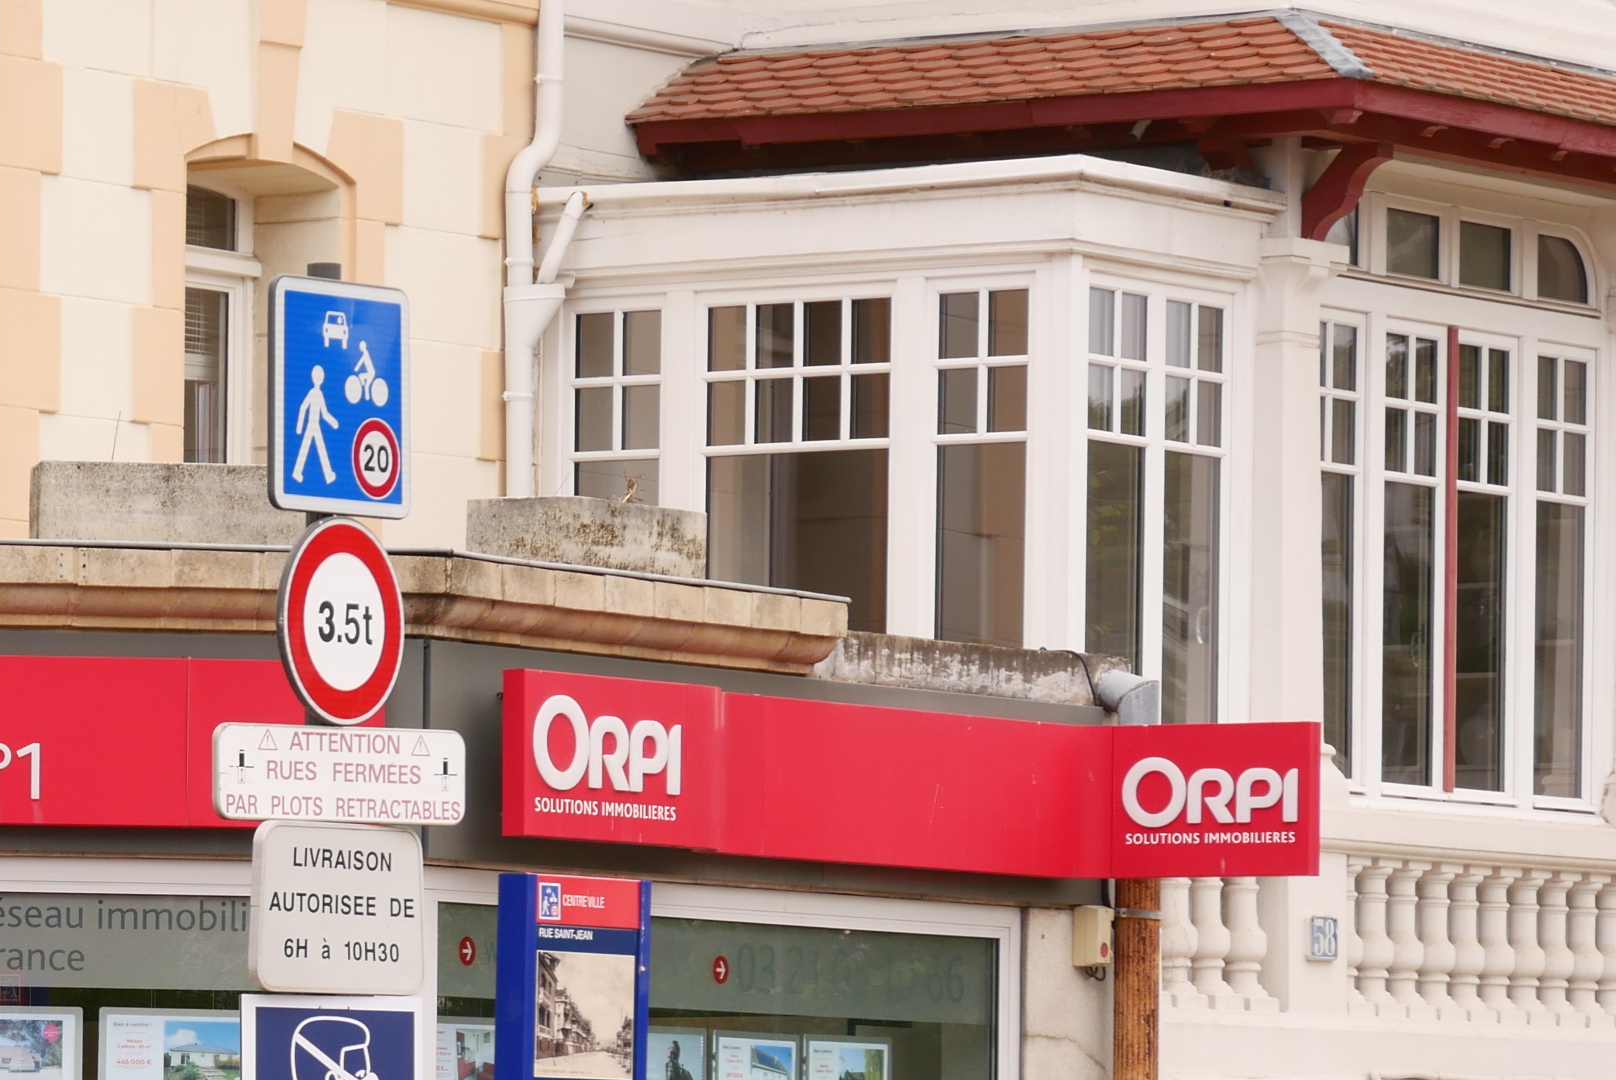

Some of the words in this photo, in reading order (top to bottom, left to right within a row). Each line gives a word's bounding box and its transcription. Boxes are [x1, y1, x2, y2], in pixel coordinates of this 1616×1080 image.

[364, 444, 389, 473] 20
[318, 601, 373, 646] 3.5t
[289, 731, 401, 755] ATTENTION
[533, 694, 681, 796] ORPI
[266, 760, 317, 781] RUES
[332, 762, 422, 784] FERMÉES
[1121, 756, 1299, 829] ORPI
[226, 794, 258, 814] PAR
[271, 796, 323, 816] PLOTS
[336, 797, 461, 821] RETRACTABLES
[534, 797, 598, 816] SOLUTIONS
[601, 801, 677, 822] IMMOBILIERES
[1125, 832, 1200, 845] SOLUTIONS
[1204, 831, 1296, 844] IMMOBILIERES
[293, 847, 392, 872] LIVRAISON
[97, 900, 249, 932] immobili
[269, 891, 377, 917] AUTORISEE
[390, 898, 415, 918] DE
[538, 928, 554, 938] RUE
[1314, 919, 1335, 957] 58
[284, 938, 308, 958] 6H
[321, 938, 331, 959] à
[344, 941, 400, 962] 10H30
